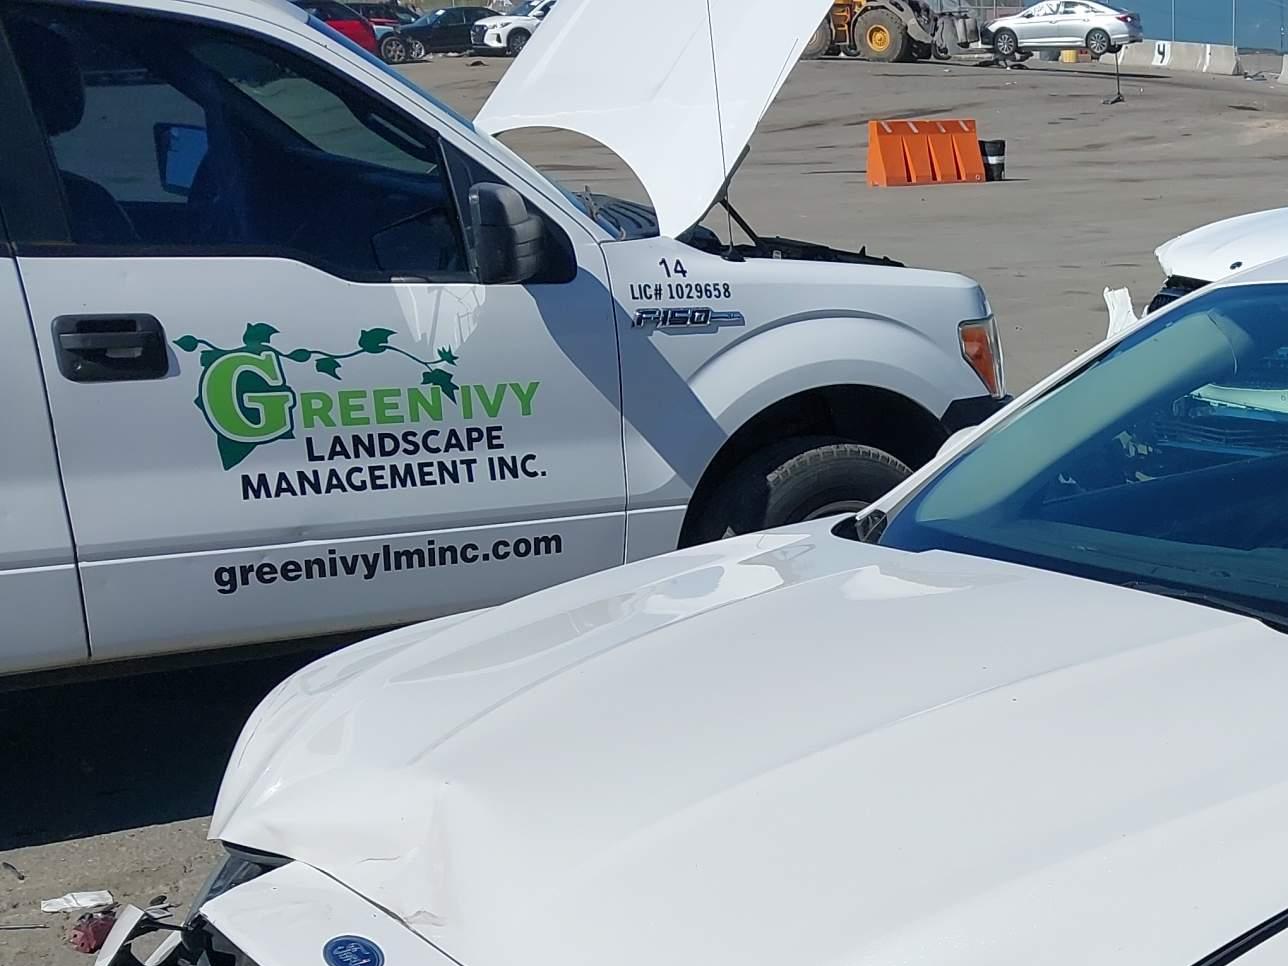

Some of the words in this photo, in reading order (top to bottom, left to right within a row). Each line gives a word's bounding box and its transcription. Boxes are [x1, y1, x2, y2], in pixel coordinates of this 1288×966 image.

[1157, 43, 1166, 64] 4
[658, 257, 688, 278] 14
[630, 283, 663, 301] LIC#
[667, 282, 732, 300] 1029658
[461, 381, 541, 418] IVY
[305, 425, 505, 463] LANDSCAPE
[240, 457, 478, 500] MANAGEMENT
[486, 452, 548, 480] INC.
[213, 530, 564, 594] greenivylminc.com
